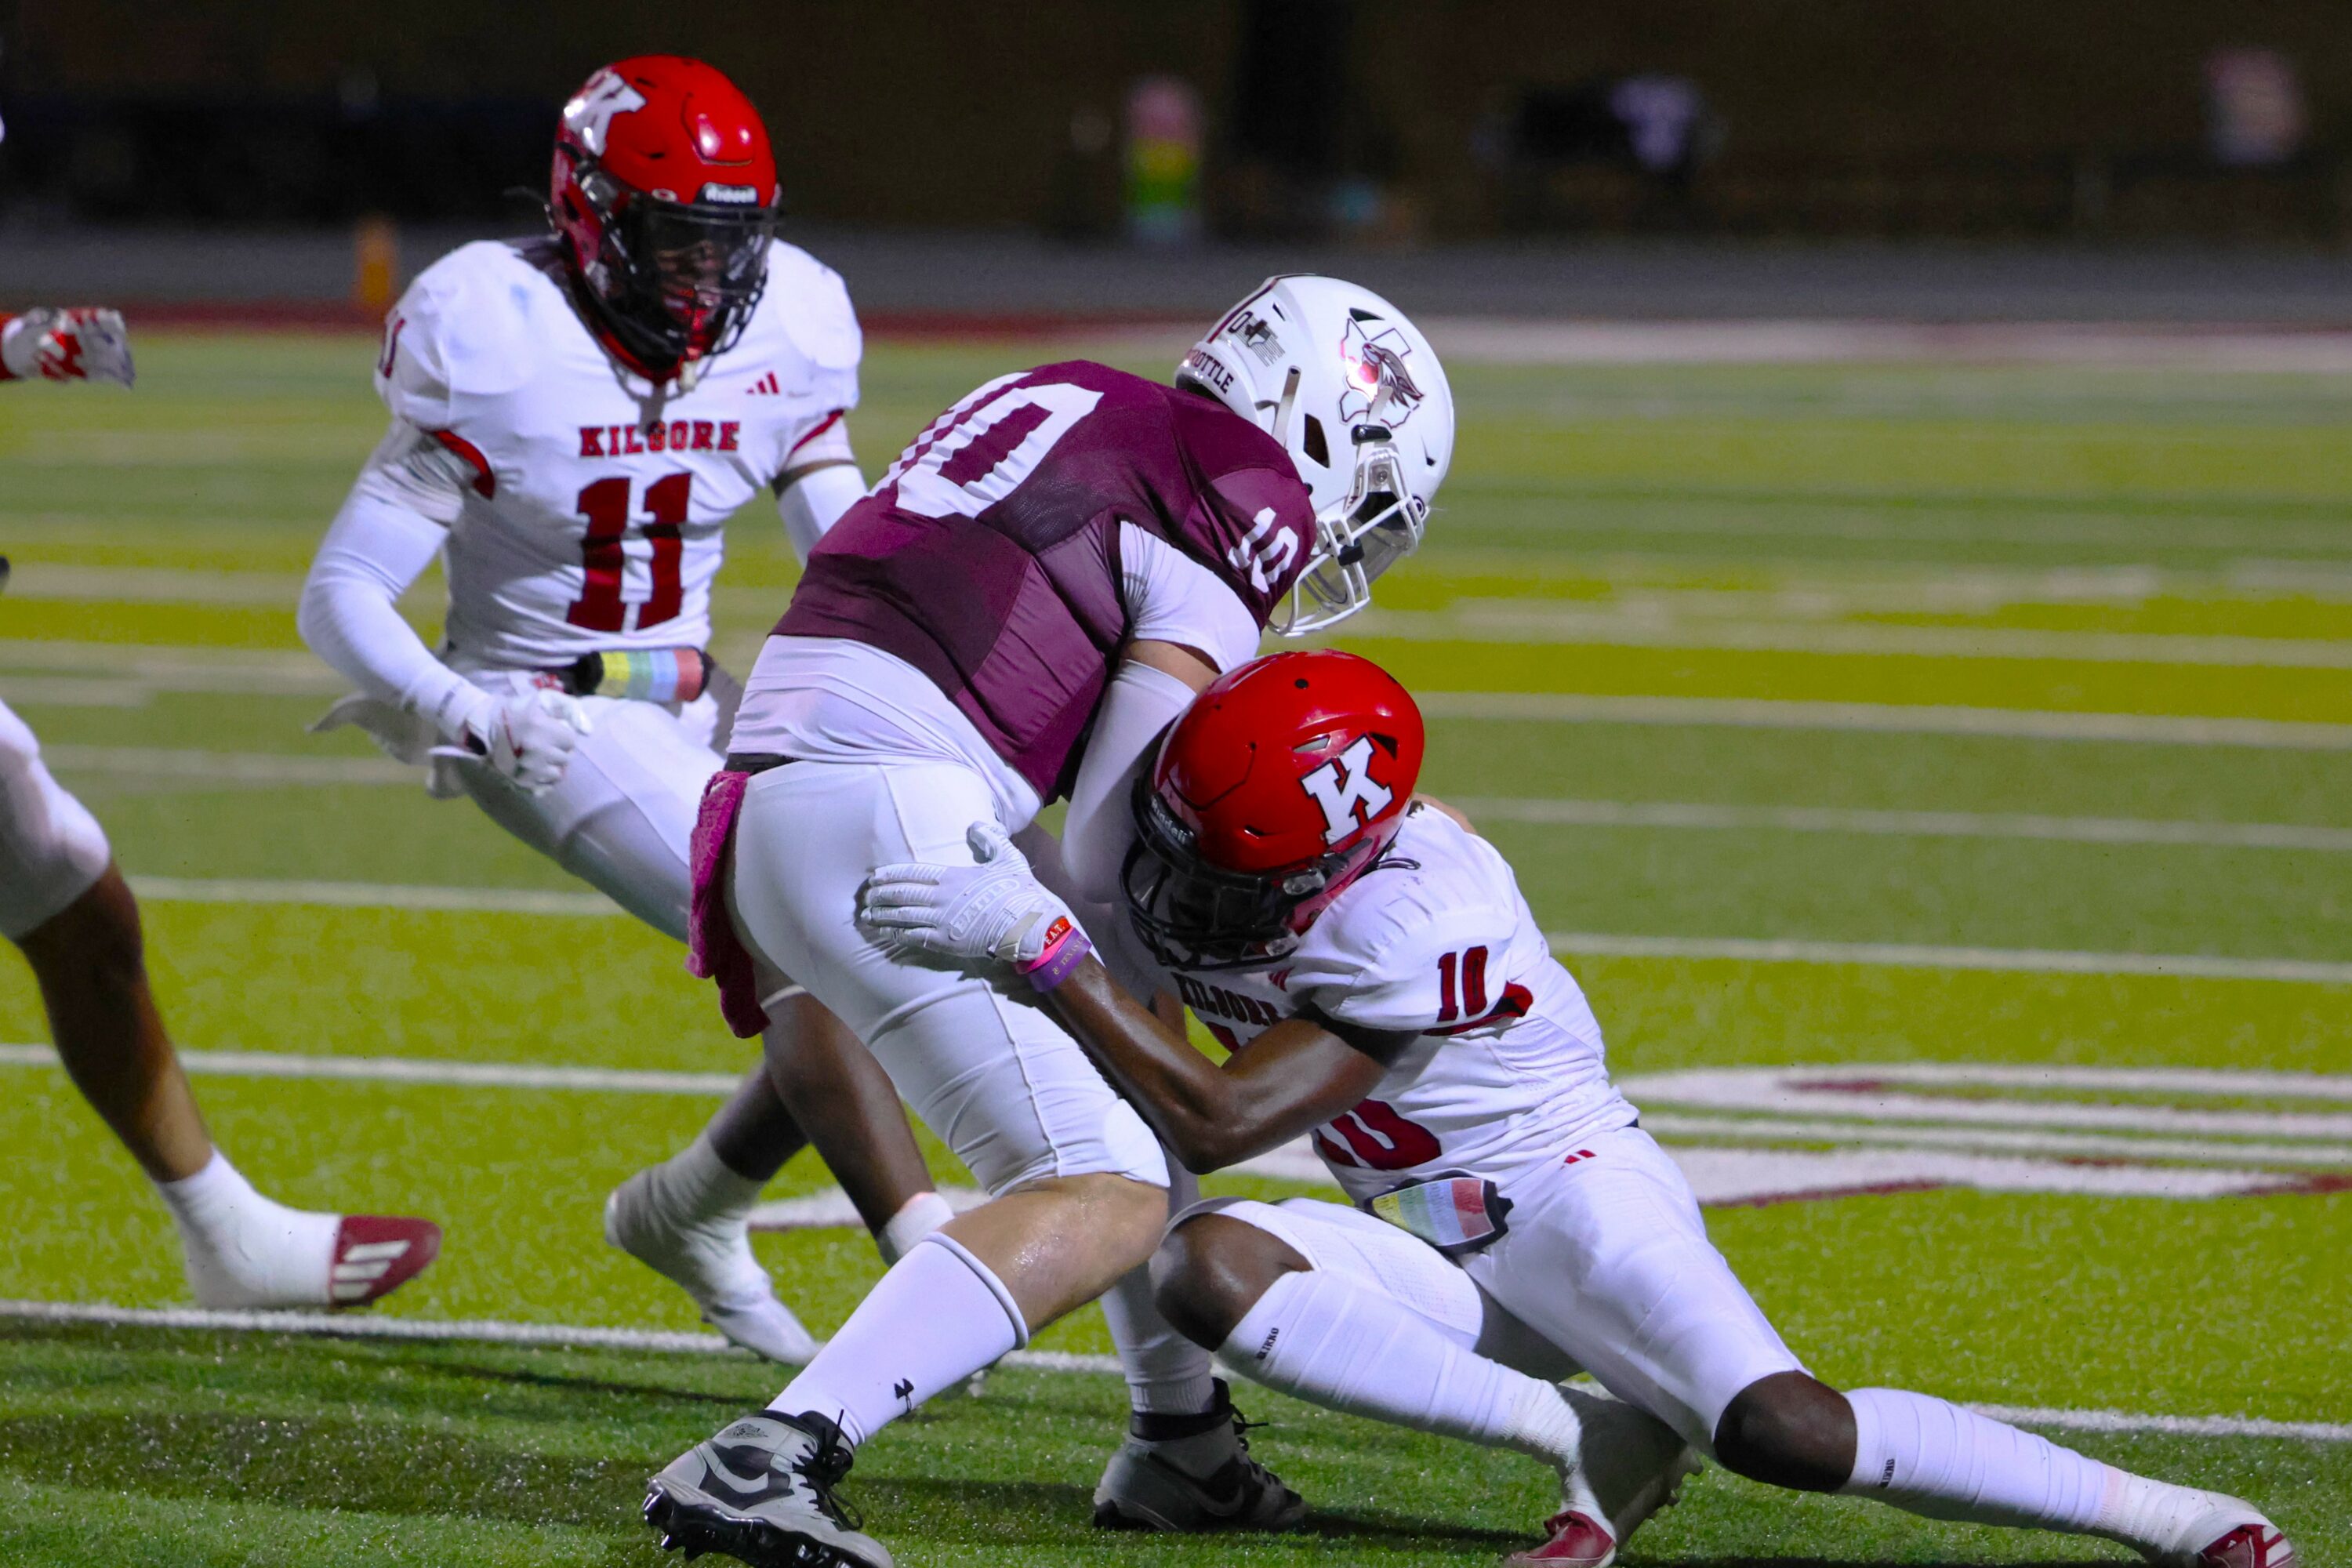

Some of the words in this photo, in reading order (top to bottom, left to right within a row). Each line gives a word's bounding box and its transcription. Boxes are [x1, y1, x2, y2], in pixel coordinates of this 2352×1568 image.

[579, 420, 740, 457] KILGORE
[867, 372, 1105, 519] 10
[566, 472, 691, 631] 11
[1228, 506, 1299, 593] 10
[1300, 732, 1394, 845] K
[1437, 945, 1489, 1022] 10
